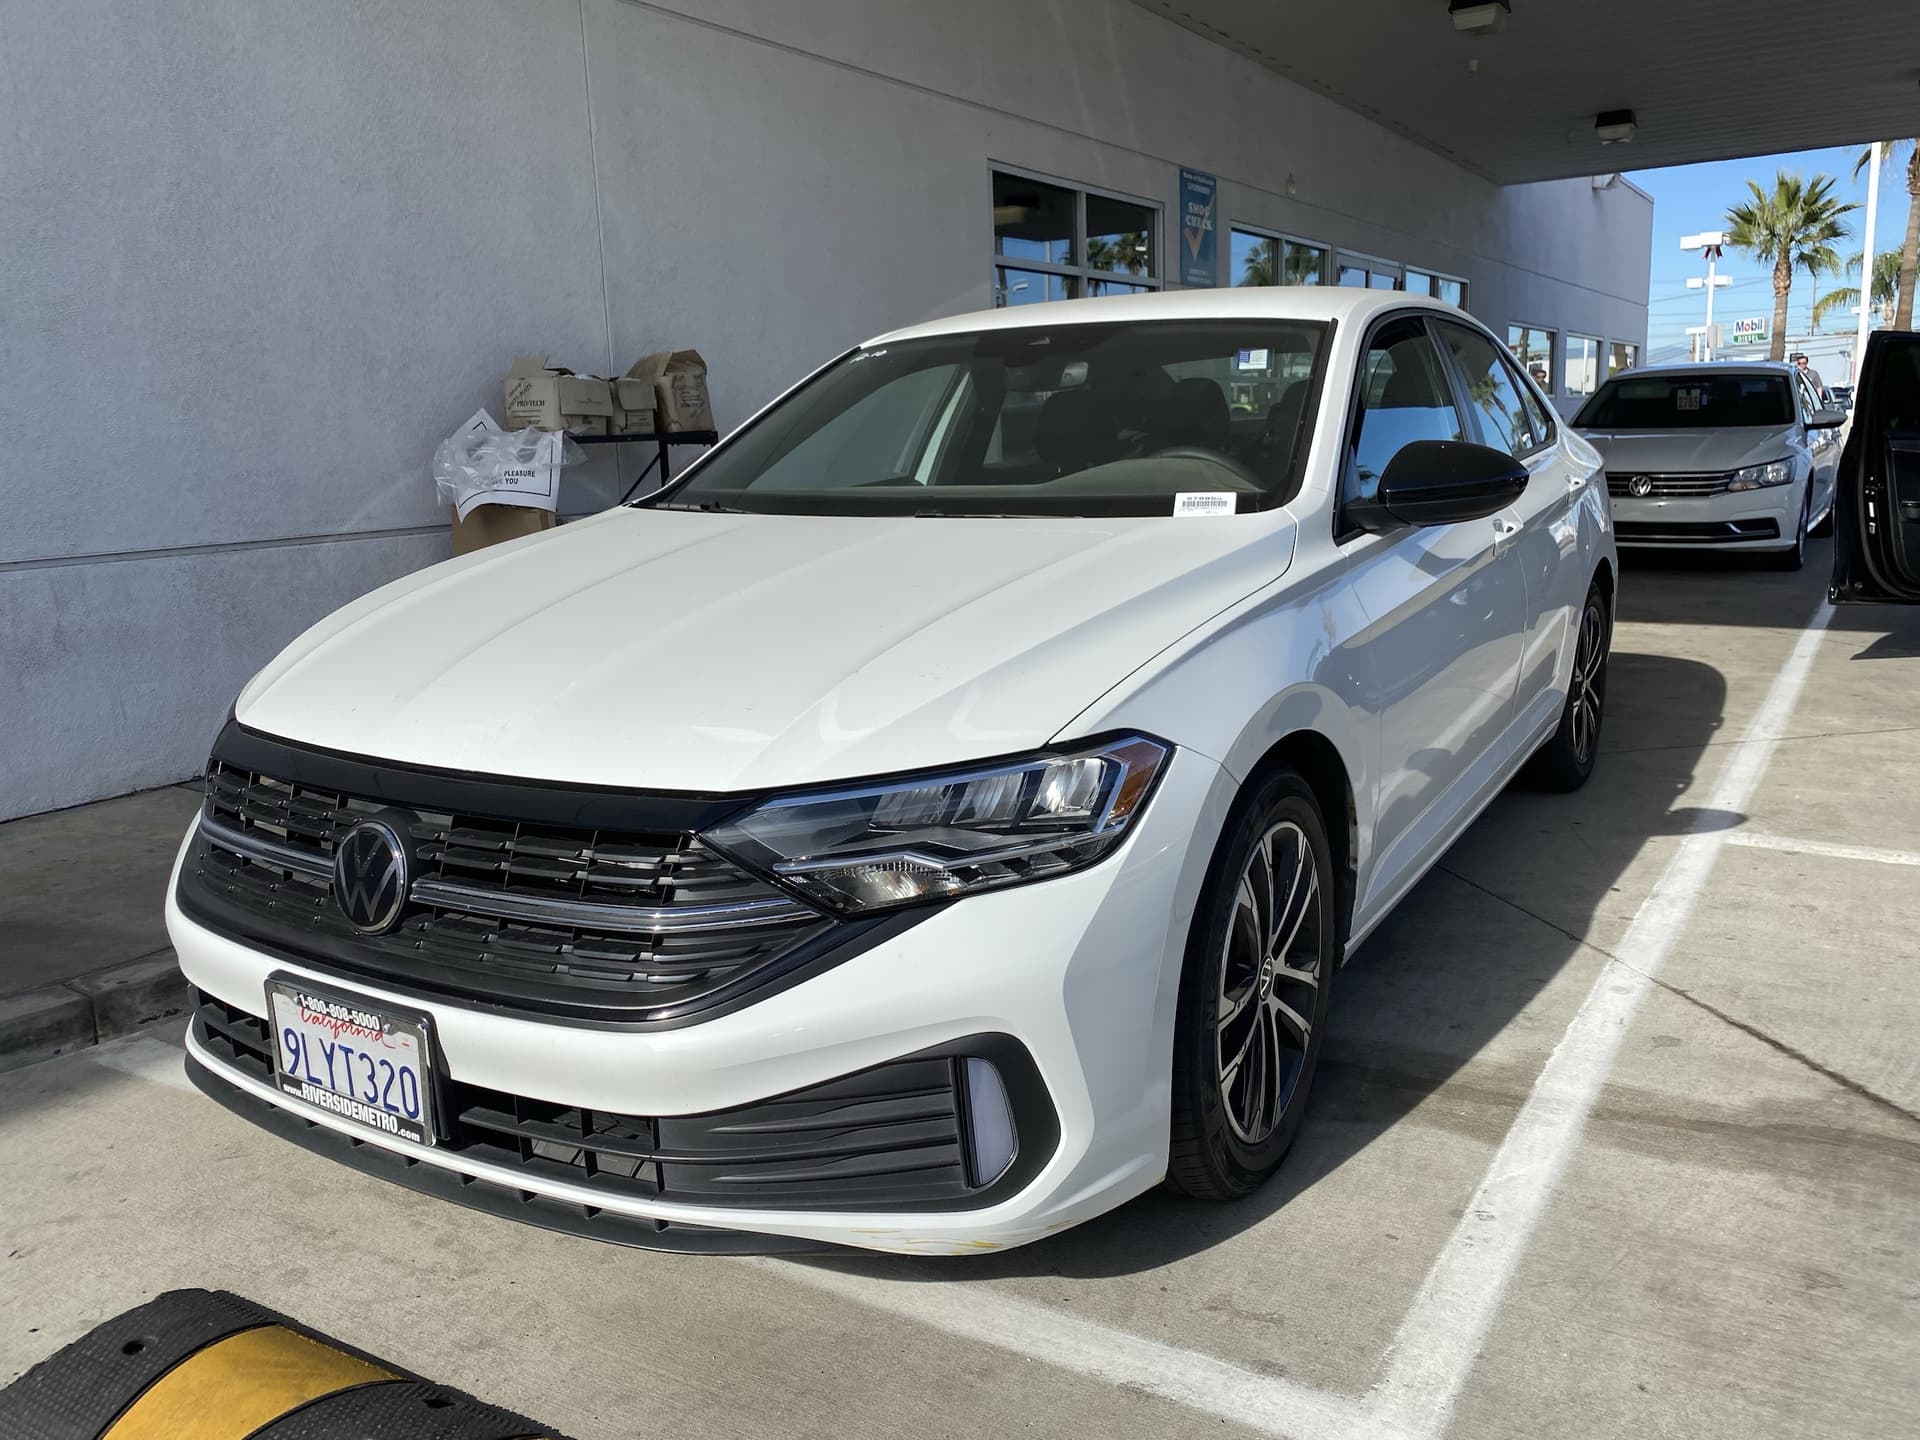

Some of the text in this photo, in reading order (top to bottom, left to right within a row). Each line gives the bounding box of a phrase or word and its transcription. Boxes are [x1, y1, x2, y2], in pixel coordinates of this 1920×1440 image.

[1735, 319, 1763, 333] Mobil
[503, 470, 536, 478] PLEASURE
[505, 477, 519, 485] YOU
[300, 1007, 396, 1050] California
[283, 1027, 420, 1120] 9LYT320
